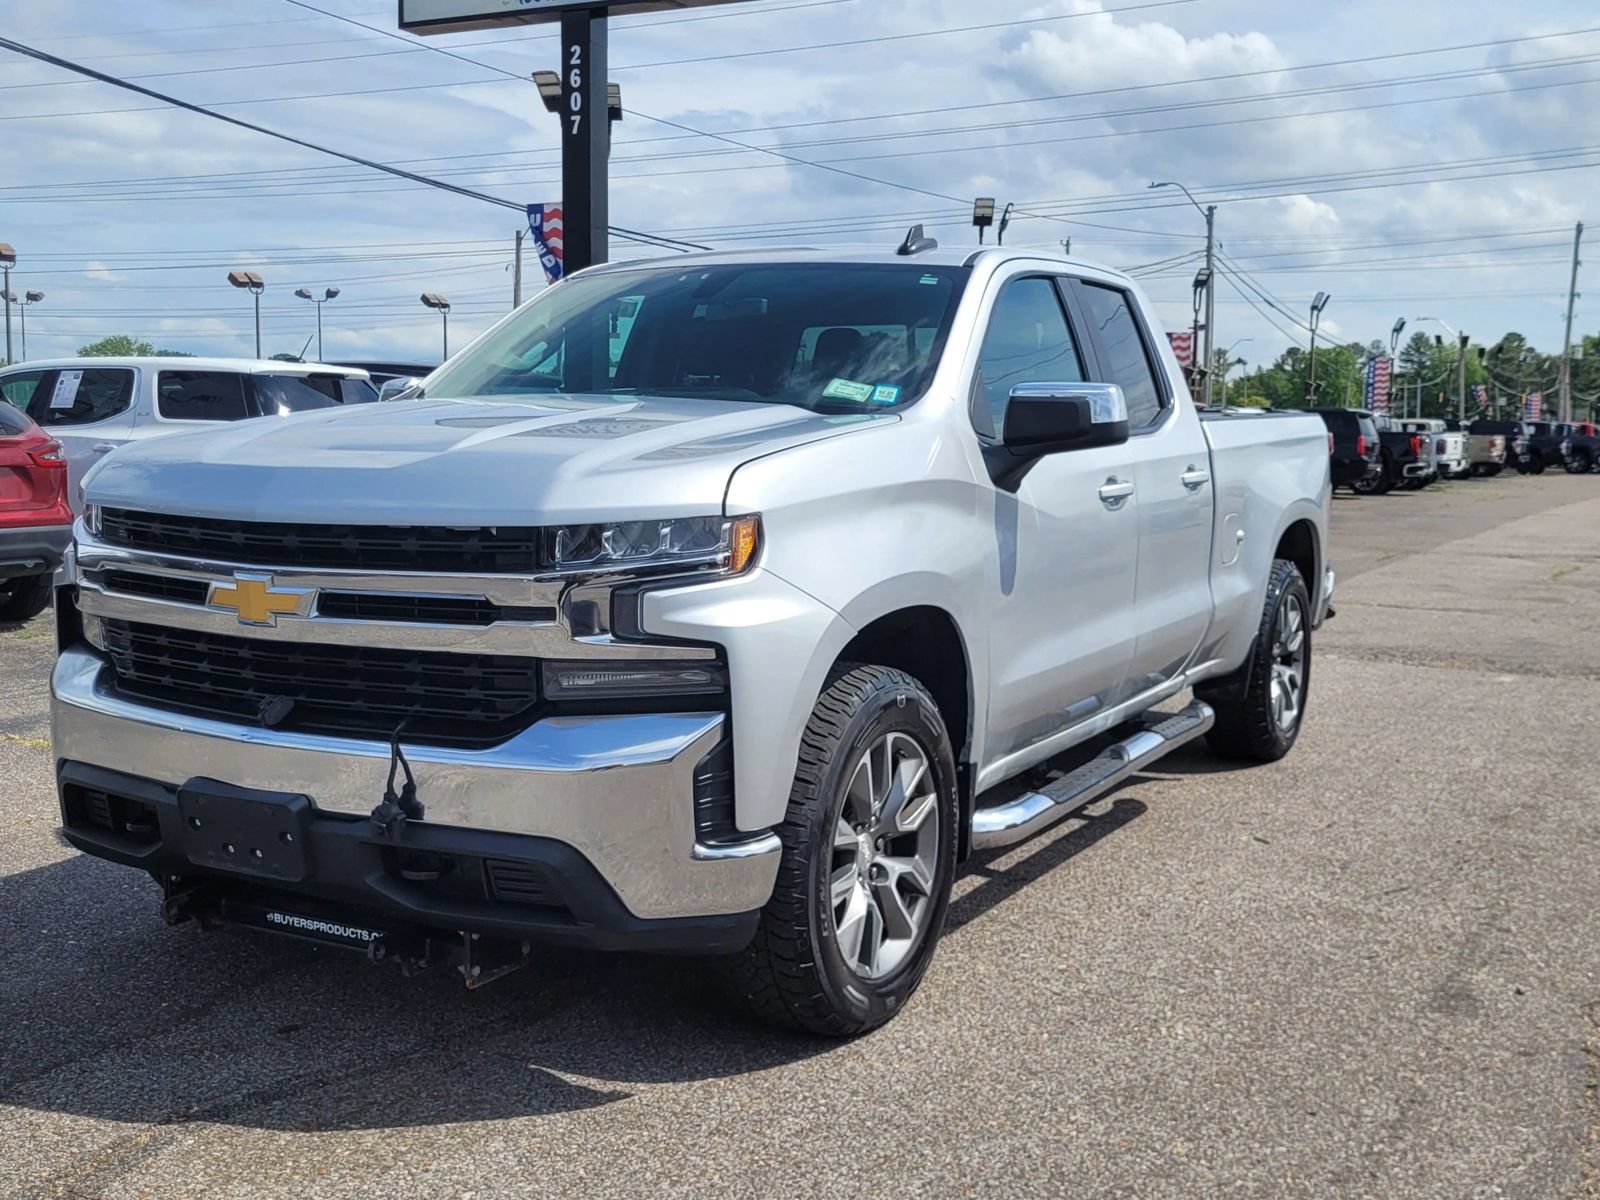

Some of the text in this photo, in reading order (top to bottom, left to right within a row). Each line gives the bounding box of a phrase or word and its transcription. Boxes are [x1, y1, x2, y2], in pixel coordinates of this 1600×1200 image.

[569, 44, 582, 135] 2607
[529, 213, 556, 268] UED
[273, 912, 384, 942] BUYERSPRODUCTS.C
